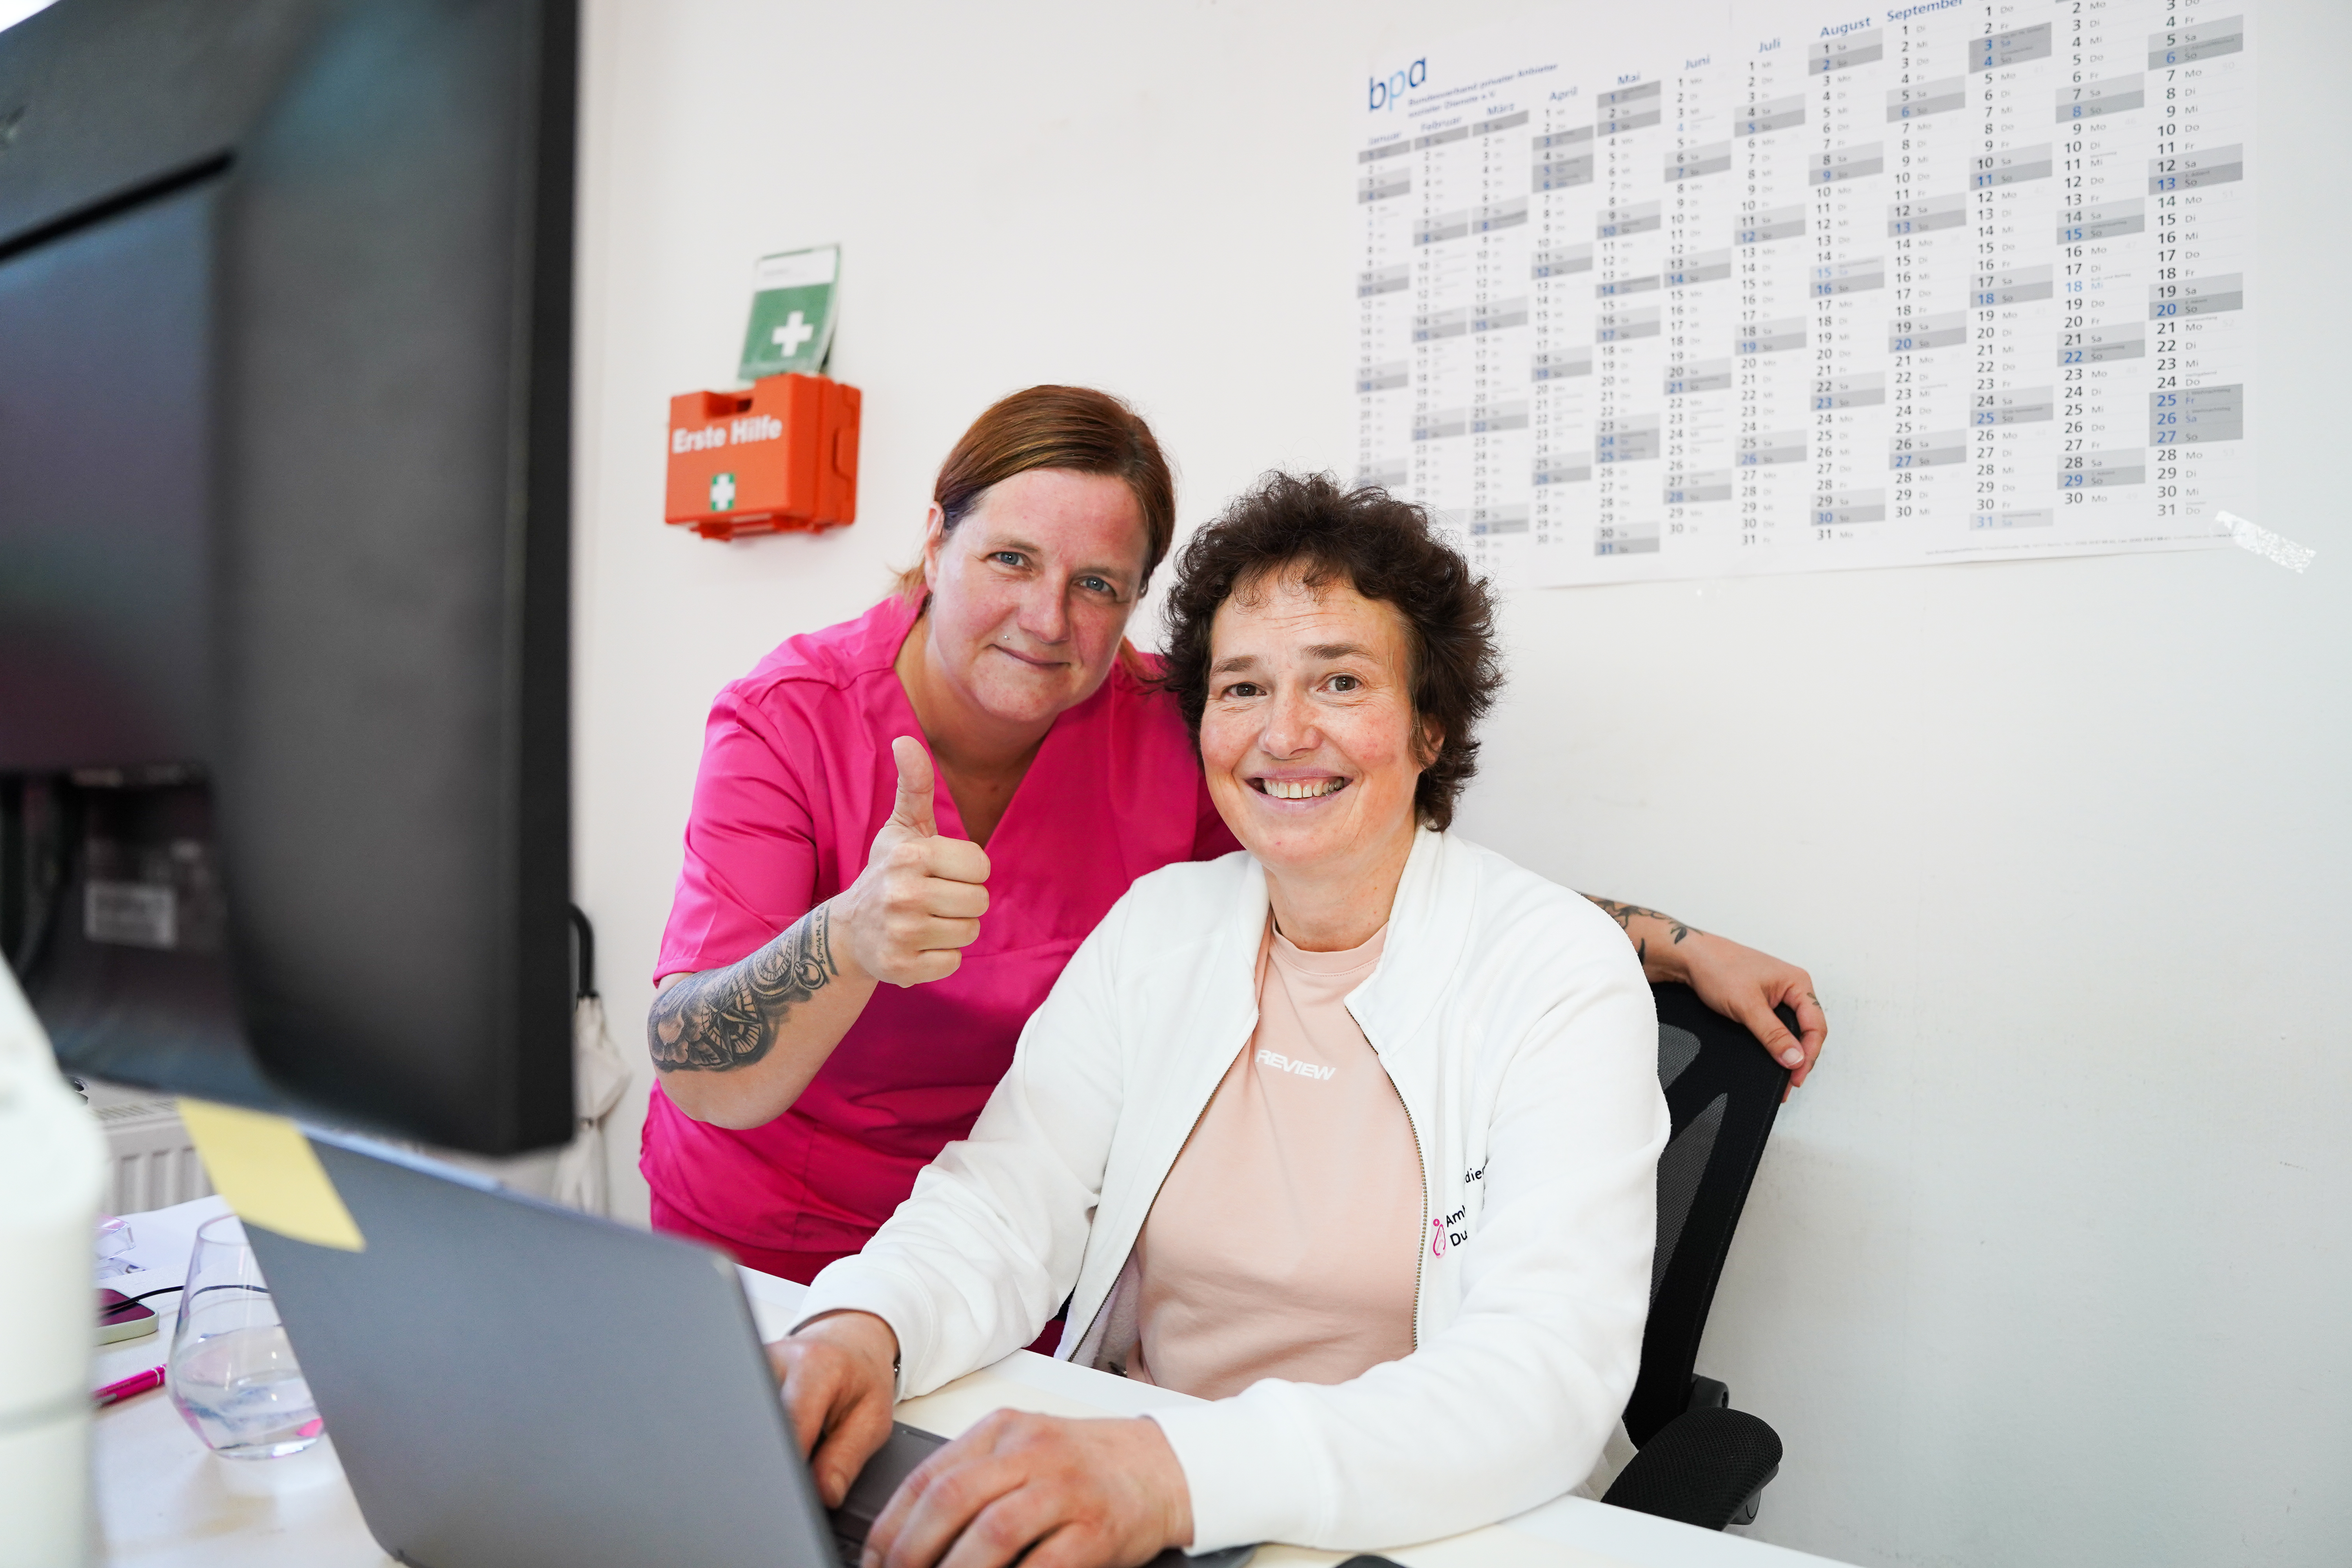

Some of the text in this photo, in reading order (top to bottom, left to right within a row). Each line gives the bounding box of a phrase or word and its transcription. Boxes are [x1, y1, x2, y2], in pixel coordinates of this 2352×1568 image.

[1985, 5, 1991, 17] 1
[2167, 0, 2176, 11] 3
[1819, 17, 1871, 38] August
[2072, 19, 2081, 32] 3
[2165, 15, 2195, 28] 4 Fr
[1758, 38, 1781, 53] Juli
[2167, 33, 2197, 47] 5 Sa
[1685, 54, 1711, 70] Juni
[2165, 51, 2198, 64] 6 So
[1617, 72, 1641, 85] Mai
[1984, 73, 1993, 85] 5
[2072, 71, 2082, 83] 6
[2167, 69, 2202, 82] 7 Mo
[1368, 56, 1426, 113] bpa
[1549, 86, 1578, 102] April
[1902, 90, 1910, 102] 5
[2166, 87, 2196, 100] 8 Di
[1487, 103, 1515, 115] März
[2166, 105, 2198, 118] 9 Mi
[1421, 117, 1462, 131] Februar
[1822, 122, 1831, 134] 6
[1984, 123, 1993, 135] 8
[2073, 123, 2082, 136] 9
[2158, 123, 2200, 137] 10 Do
[2158, 141, 2194, 155] 11 Fr
[2158, 159, 2197, 173] 12 Sa
[1895, 172, 1911, 184] 10
[2065, 175, 2082, 189] 12
[2157, 177, 2198, 191] 13 So
[1816, 186, 1831, 198] 10
[1978, 191, 1993, 203] 12
[1741, 200, 1756, 212] 10
[2158, 195, 2203, 209] 14 Mo
[1895, 204, 1910, 217] 12
[2065, 211, 2082, 224] 14
[2158, 214, 2196, 227] 15 Di
[1671, 228, 1683, 240] 11
[2158, 231, 2198, 244] 16 Mi
[1602, 240, 1615, 251] 11
[1978, 242, 1994, 254] 15
[2065, 245, 2083, 258] 16
[1537, 252, 1550, 262] 11
[1742, 247, 1755, 258] 13
[2158, 249, 2200, 262] 17 Do
[1896, 255, 1911, 267] 15
[1670, 273, 1684, 284] 14
[2158, 267, 2195, 280] 18 Fr
[1817, 283, 1832, 295] 16
[2065, 281, 2083, 293] 18
[2158, 285, 2197, 298] 19 Sa
[1978, 310, 1994, 322] 19
[2156, 303, 2198, 317] 20 So
[1896, 321, 1912, 334] 19
[2064, 315, 2083, 329] 20
[2157, 321, 2203, 335] 21 Mo
[2157, 339, 2197, 353] 22 Di
[1816, 348, 1833, 361] 20
[1740, 358, 1757, 370] 20
[1977, 361, 1994, 374] 22
[2157, 357, 2199, 371] 23 Mi
[2064, 368, 2083, 381] 23
[2157, 376, 2201, 389] 24 Do
[1601, 390, 1614, 402] 21
[2157, 394, 2195, 407] 25 Fr
[1669, 397, 1683, 409] 22
[2157, 412, 2198, 426] 26 Sa
[672, 414, 783, 454] Erste Hilfe
[1895, 422, 1912, 434] 25
[2064, 421, 2083, 434] 26
[1817, 430, 1833, 442] 25
[1977, 429, 1994, 442] 26
[2157, 430, 2199, 444] 27 So
[2157, 448, 2203, 462] 28 Mo
[2064, 456, 2083, 470] 28
[1741, 469, 1757, 481] 27
[2157, 466, 2197, 480] 29 Di
[1817, 479, 1832, 491] 28
[2065, 492, 2083, 505] 30
[2158, 485, 2199, 499] 30 Mi
[1977, 498, 1995, 511] 30
[2158, 503, 2201, 517] 31 Do
[1255, 1049, 1336, 1081] REVIEW
